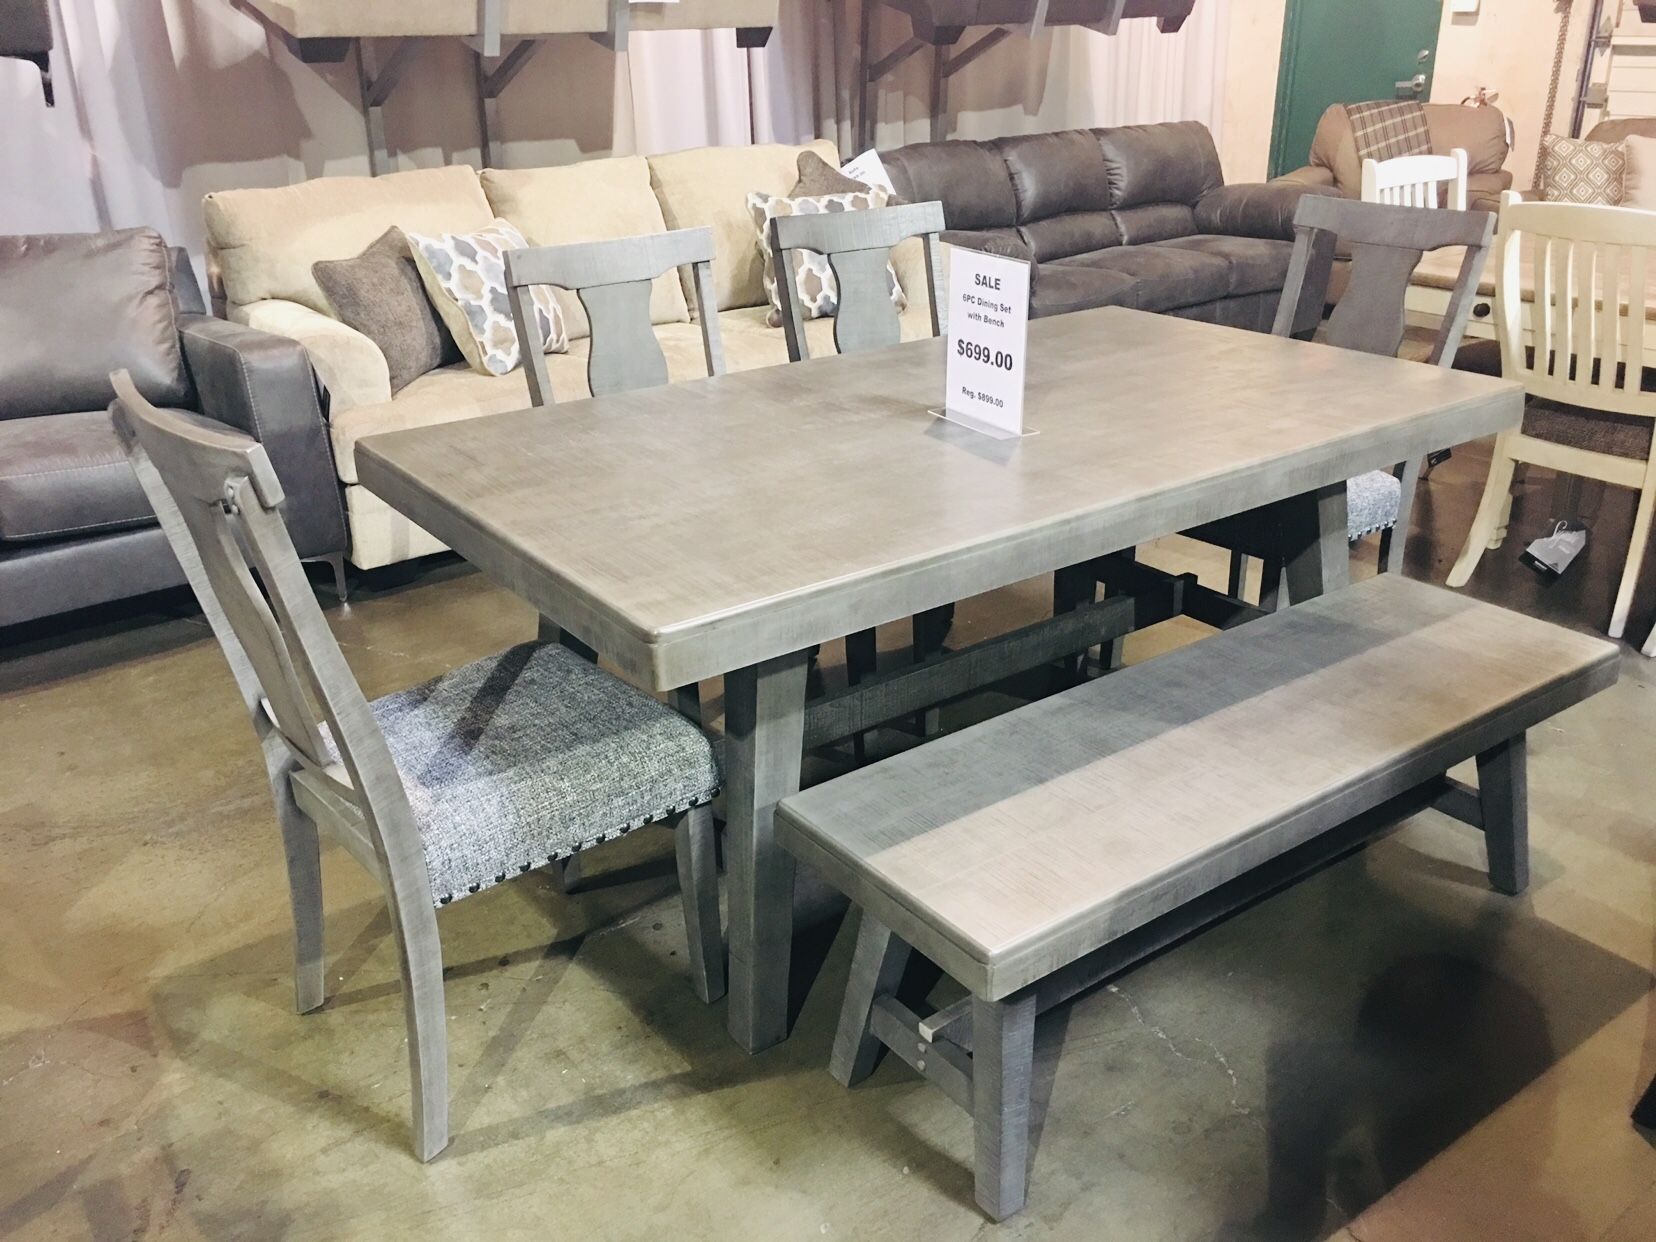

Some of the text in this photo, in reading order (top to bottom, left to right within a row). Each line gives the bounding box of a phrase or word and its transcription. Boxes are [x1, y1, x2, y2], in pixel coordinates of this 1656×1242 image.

[974, 273, 1001, 291] SALE
[962, 293, 1012, 315] 6PC Dining Set
[967, 312, 1005, 328] with Bench
[957, 338, 1013, 371] $699.00
[962, 386, 1004, 408] Reg. $899.00
